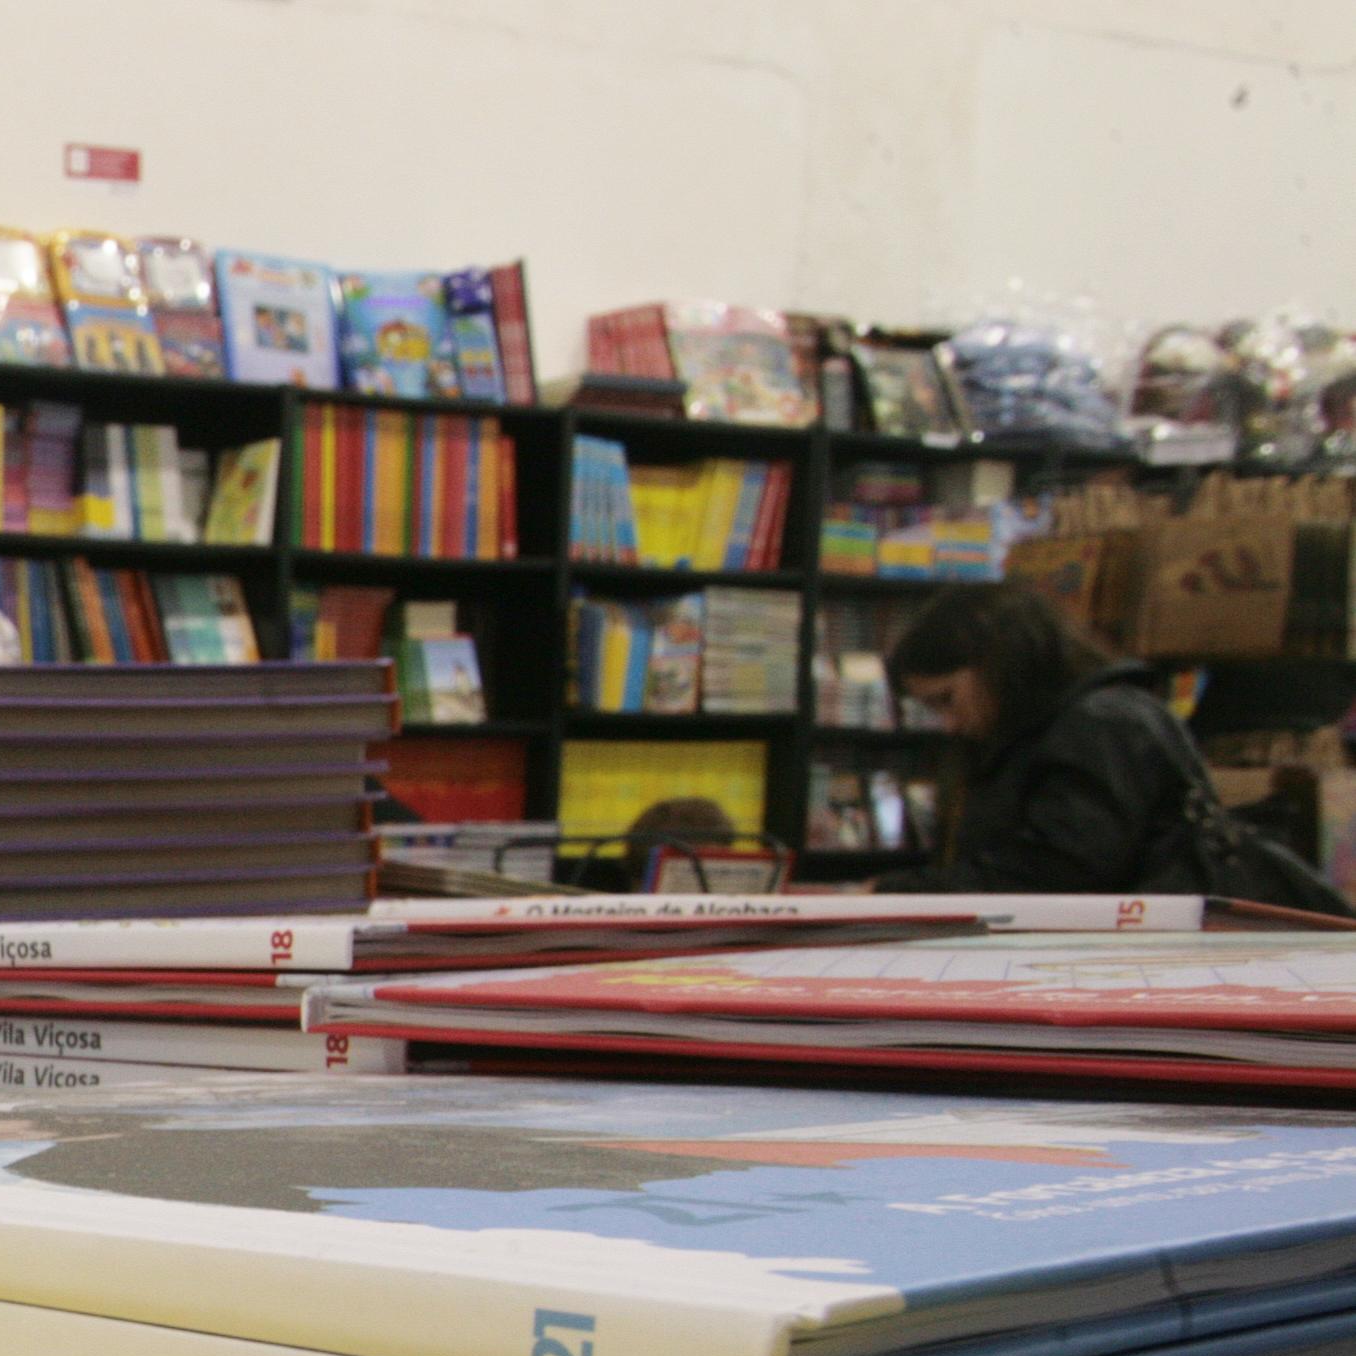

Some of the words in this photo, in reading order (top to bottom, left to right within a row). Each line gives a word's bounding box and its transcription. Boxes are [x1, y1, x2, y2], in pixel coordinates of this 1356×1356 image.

[1116, 899, 1146, 930] 15
[271, 929, 294, 964] 18
[33, 1025, 103, 1058] Viçosa
[324, 1032, 351, 1069] 18
